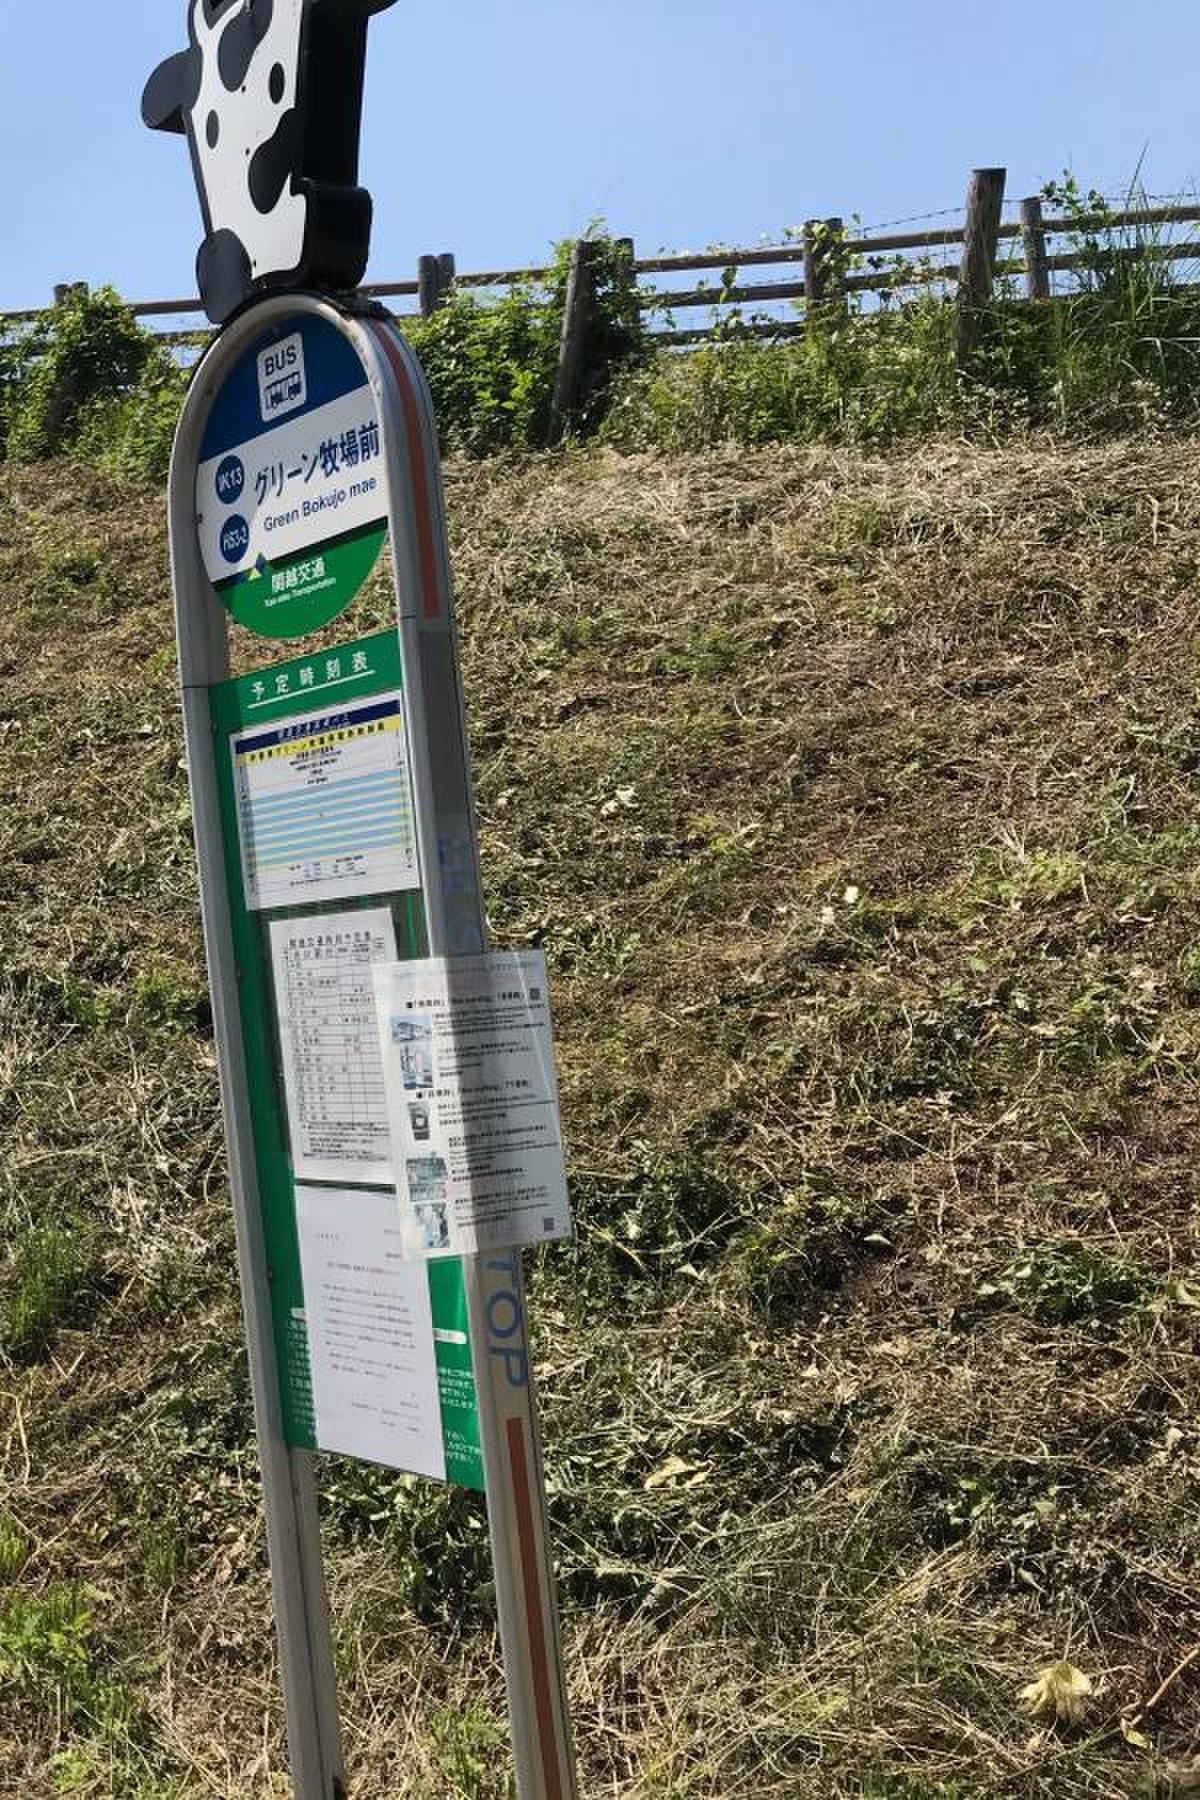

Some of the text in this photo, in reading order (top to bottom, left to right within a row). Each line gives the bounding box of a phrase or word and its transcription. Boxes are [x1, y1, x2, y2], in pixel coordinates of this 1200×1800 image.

[263, 345, 298, 377] BUS
[254, 420, 379, 506] グリーン牧場前
[263, 477, 377, 531] Green Bokujo mae
[271, 556, 325, 592] 関越交通
[251, 650, 369, 701] 予定時刻表
[486, 1250, 528, 1388] TOP
